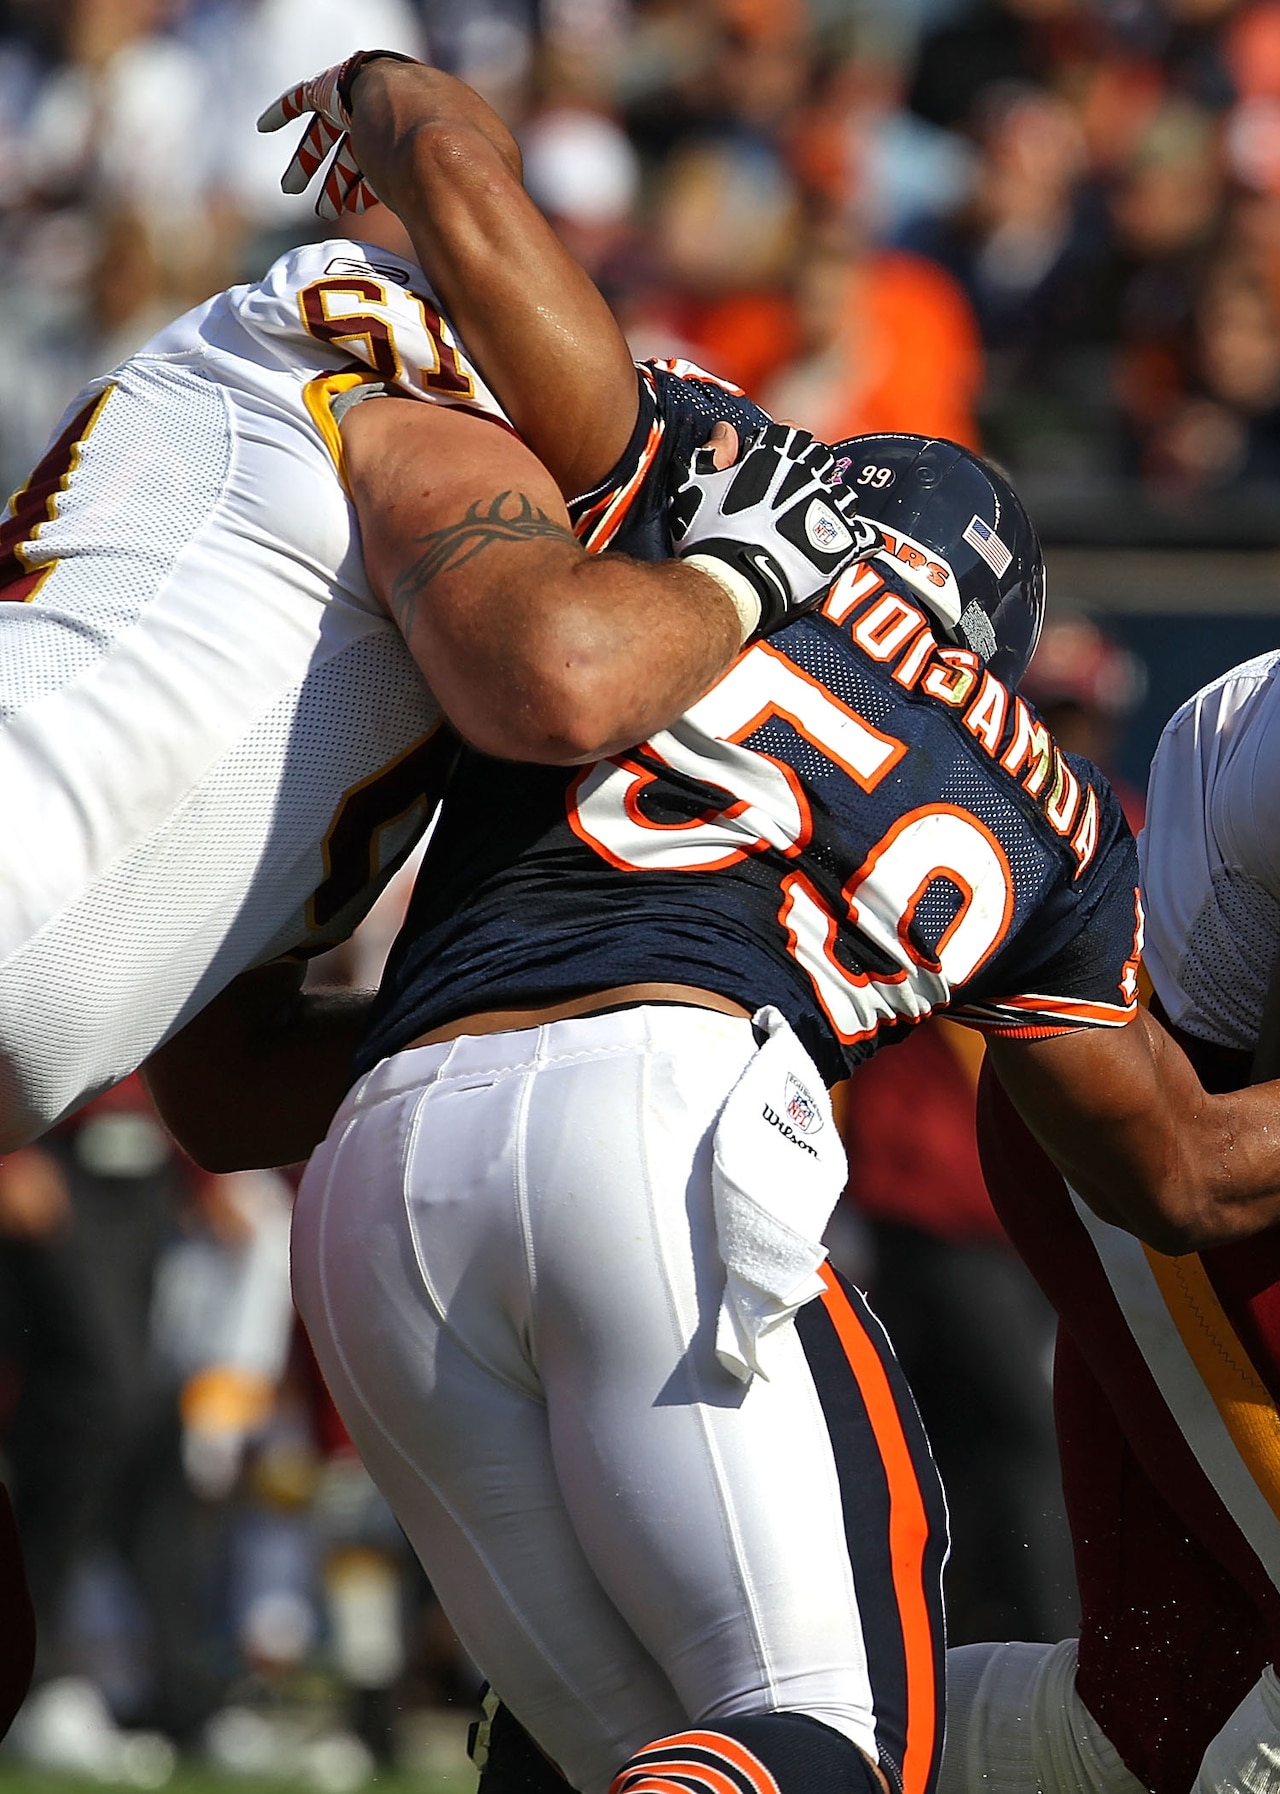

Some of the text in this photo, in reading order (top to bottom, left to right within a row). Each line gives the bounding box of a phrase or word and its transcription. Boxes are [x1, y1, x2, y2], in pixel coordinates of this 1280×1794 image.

[856, 464, 894, 489] 99
[813, 525, 834, 546] NFL
[787, 1100, 806, 1128] NFL
[762, 1102, 820, 1159] Wilson
